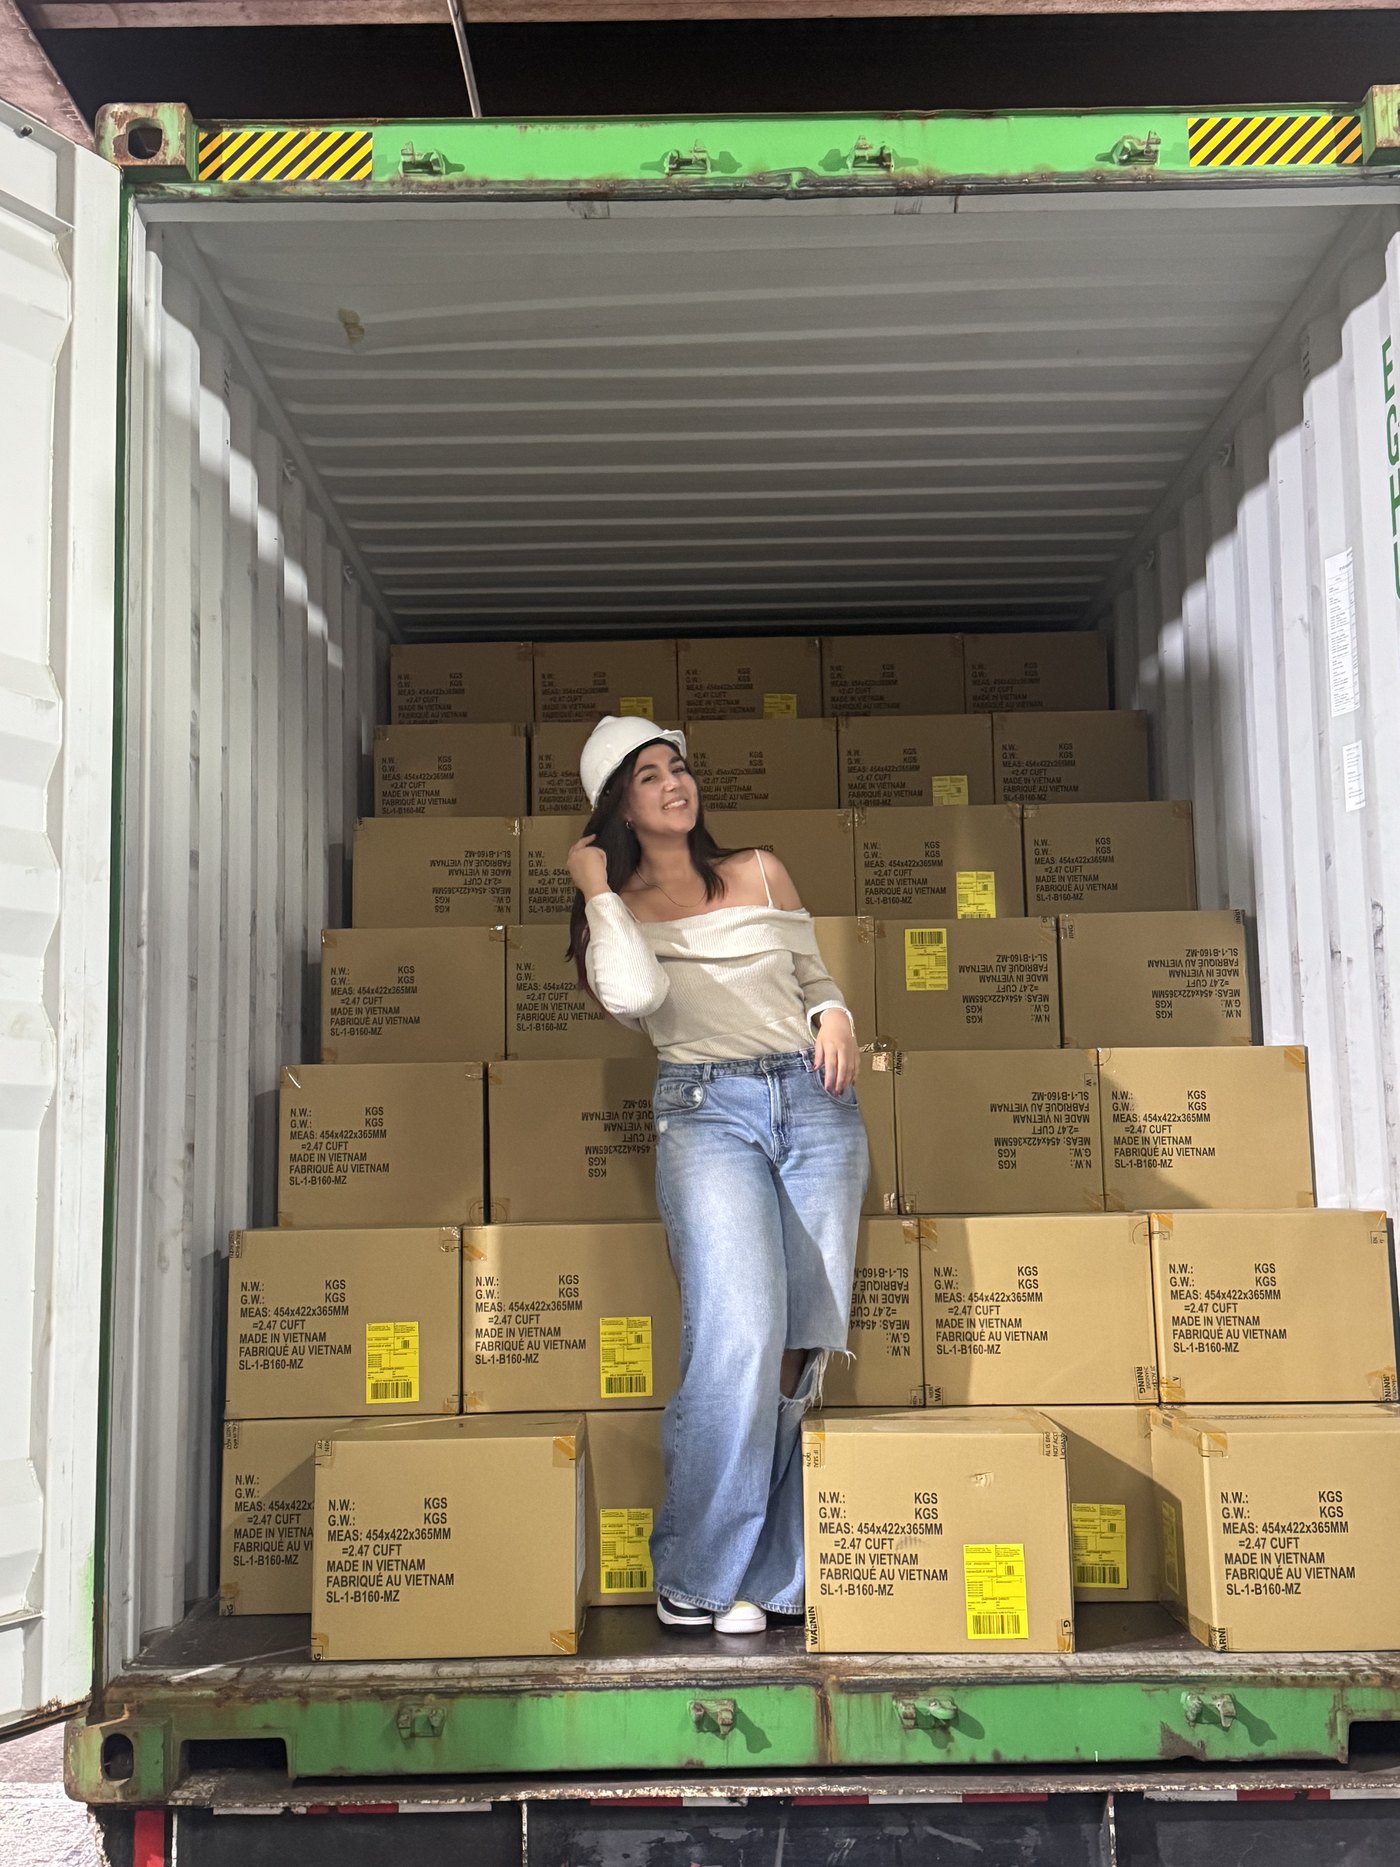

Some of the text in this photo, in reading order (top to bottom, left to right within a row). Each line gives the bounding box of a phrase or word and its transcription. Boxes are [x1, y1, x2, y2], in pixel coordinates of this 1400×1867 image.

[1148, 960, 1183, 969] VIETNAM
[1185, 960, 1196, 968] AU
[398, 966, 415, 974] KGS
[1169, 970, 1204, 978] VIETNAM
[1216, 969, 1239, 977] MADE
[398, 976, 414, 984] KGS
[1186, 980, 1207, 988] CUFT
[1215, 990, 1240, 998] MEAS:
[363, 996, 383, 1005] CUFT
[1155, 1000, 1172, 1009] KGS
[331, 1006, 400, 1016] MADE IN VIETNAM
[1156, 1011, 1172, 1019] KGS
[372, 1017, 383, 1025] AU
[385, 1016, 420, 1025] VIETNAM
[1188, 1090, 1206, 1099] KGS
[365, 1107, 383, 1116] KGS
[1188, 1102, 1207, 1111] KGS
[365, 1118, 383, 1127] KGS
[1113, 1113, 1210, 1123] MEAS: 454x422x365MM
[290, 1129, 386, 1140] MEAS: 454x422x365MM
[1125, 1125, 1172, 1134] =2.47 CUFT
[325, 1141, 348, 1150] CUFT
[1114, 1136, 1192, 1145] MADE IN VIETNAM
[1161, 1147, 1173, 1156] AU
[1176, 1147, 1215, 1156] VIETNAM
[290, 1152, 367, 1163] MADE IN VIETNAM
[336, 1164, 348, 1173] AU
[351, 1163, 389, 1173] VIETNAM
[1115, 1159, 1173, 1168] SL-1-B160-MZ
[289, 1175, 347, 1185] SL-1-B160-MZ
[1018, 1266, 1038, 1276] KGS
[325, 1280, 346, 1290] KGS
[1018, 1279, 1038, 1289] KGS
[325, 1292, 345, 1303] KGS
[935, 1292, 1043, 1303] MEAS: 454x422x365MM
[240, 1305, 348, 1317] MEAS: 454x422x365MM
[948, 1305, 1000, 1315] =2.47 CUFT
[253, 1319, 306, 1330] =2.47 CUFT
[936, 1318, 1022, 1329] MADE IN VIETNAM
[240, 1332, 326, 1344] MADE IN VIETNAM
[936, 1329, 1048, 1342] FABRIQUÉ AU VIETNAM
[239, 1343, 351, 1357] FABRIQUÉ AU VIETNAM
[937, 1344, 1001, 1354] SL-1-B160-MZ
[239, 1359, 303, 1370] SL-1-B160-MZ
[819, 1492, 937, 1504] N.W.: KGS
[1221, 1491, 1342, 1503] N.W.: KGS
[329, 1497, 447, 1511] N.W.: KGS
[819, 1507, 938, 1519] G.W.: KGS
[1222, 1506, 1343, 1519] G.W.: KGS
[328, 1512, 447, 1526] G.W.: KGS
[820, 1523, 942, 1535] MEAS: 454x422x365MM
[1223, 1521, 1348, 1534] MEAS: 454x422x365MM
[328, 1528, 451, 1541] MEAS: 454x422x365MM
[834, 1538, 894, 1550] =2.47 CUFT
[1239, 1537, 1300, 1549] =2.47 CUFT
[342, 1544, 402, 1556] =2.47 CUFT
[820, 1553, 918, 1565] MADE IN VIETNAM
[1225, 1552, 1325, 1564] MADE IN VIETNAM
[327, 1559, 425, 1572] MADE IN VIETNAM
[820, 1565, 947, 1581] FABRIQUÉ AU VIETNAM
[1226, 1564, 1355, 1580] FABRIQUÉ AU VIETNAM
[327, 1571, 454, 1588] FABRIQUÉ AU VIETNAM
[821, 1584, 894, 1596] SL-1-B160-MZ
[1227, 1583, 1301, 1595] SL-1-B160-MZ
[326, 1590, 400, 1603] SL-1-B160-MZ
